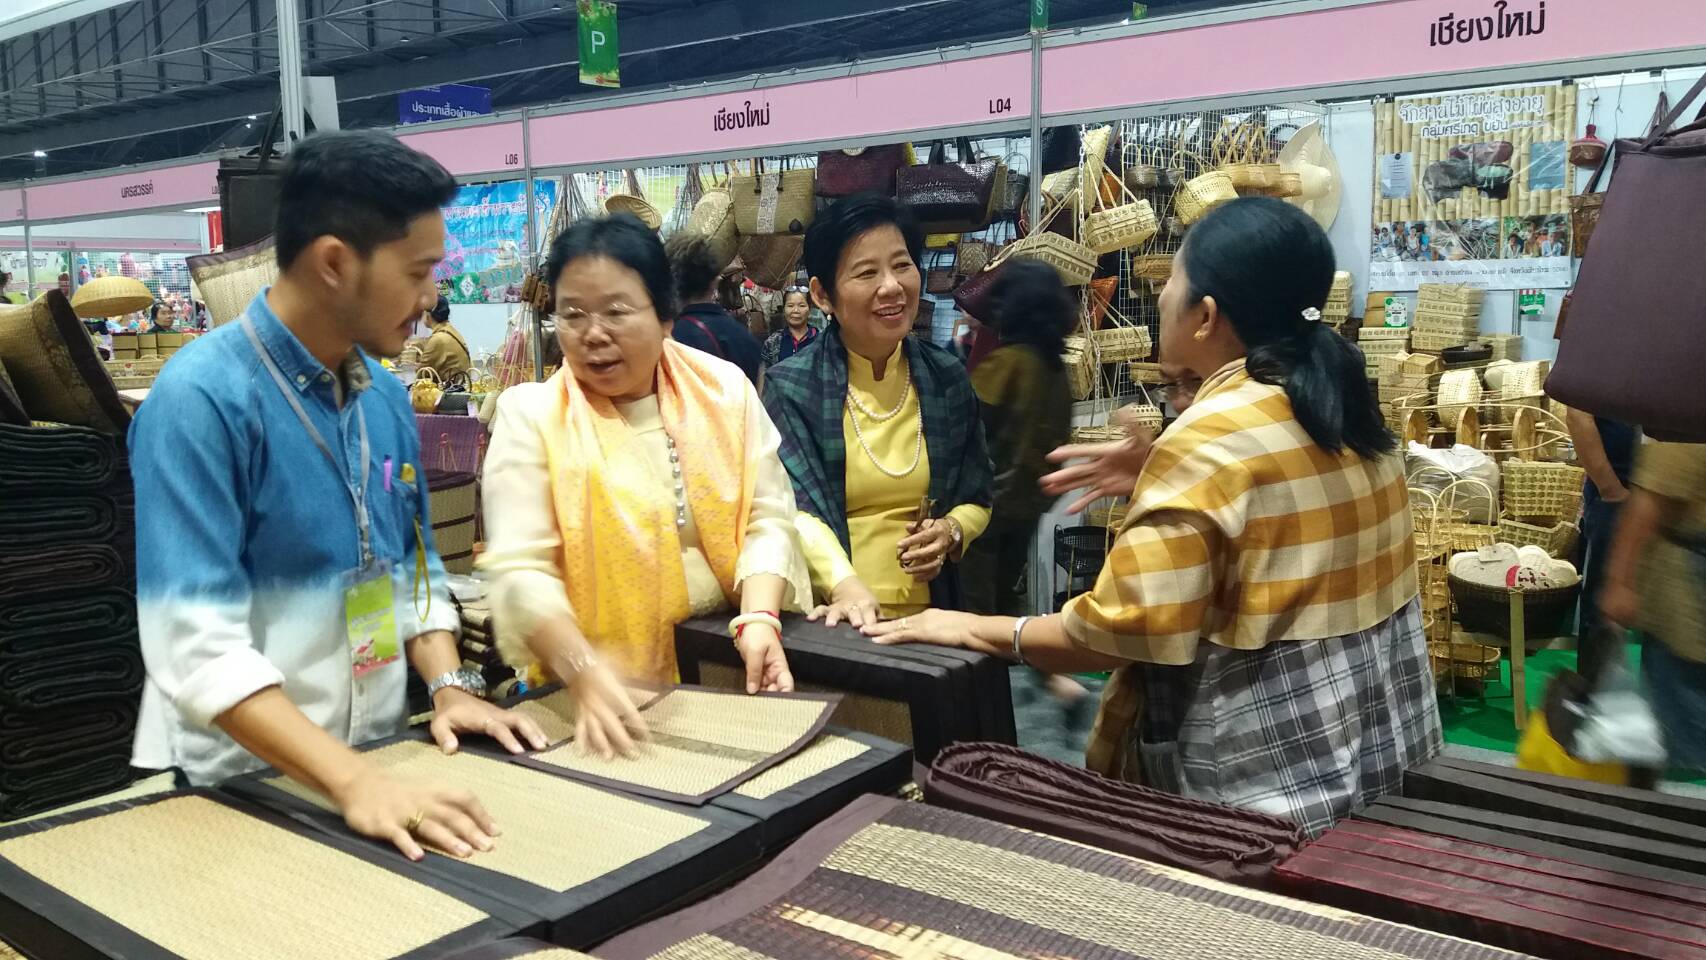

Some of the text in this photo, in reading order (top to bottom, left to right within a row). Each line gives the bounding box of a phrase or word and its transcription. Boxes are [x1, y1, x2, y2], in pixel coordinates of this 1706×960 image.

[1036, 0, 1043, 15] S
[1430, 0, 1545, 46] เชียงใหม่
[591, 31, 605, 54] P
[989, 98, 1011, 114] L04
[713, 101, 770, 131] เชียงใหม่
[505, 153, 518, 165] L06
[121, 179, 154, 198] นครสวรรค์
